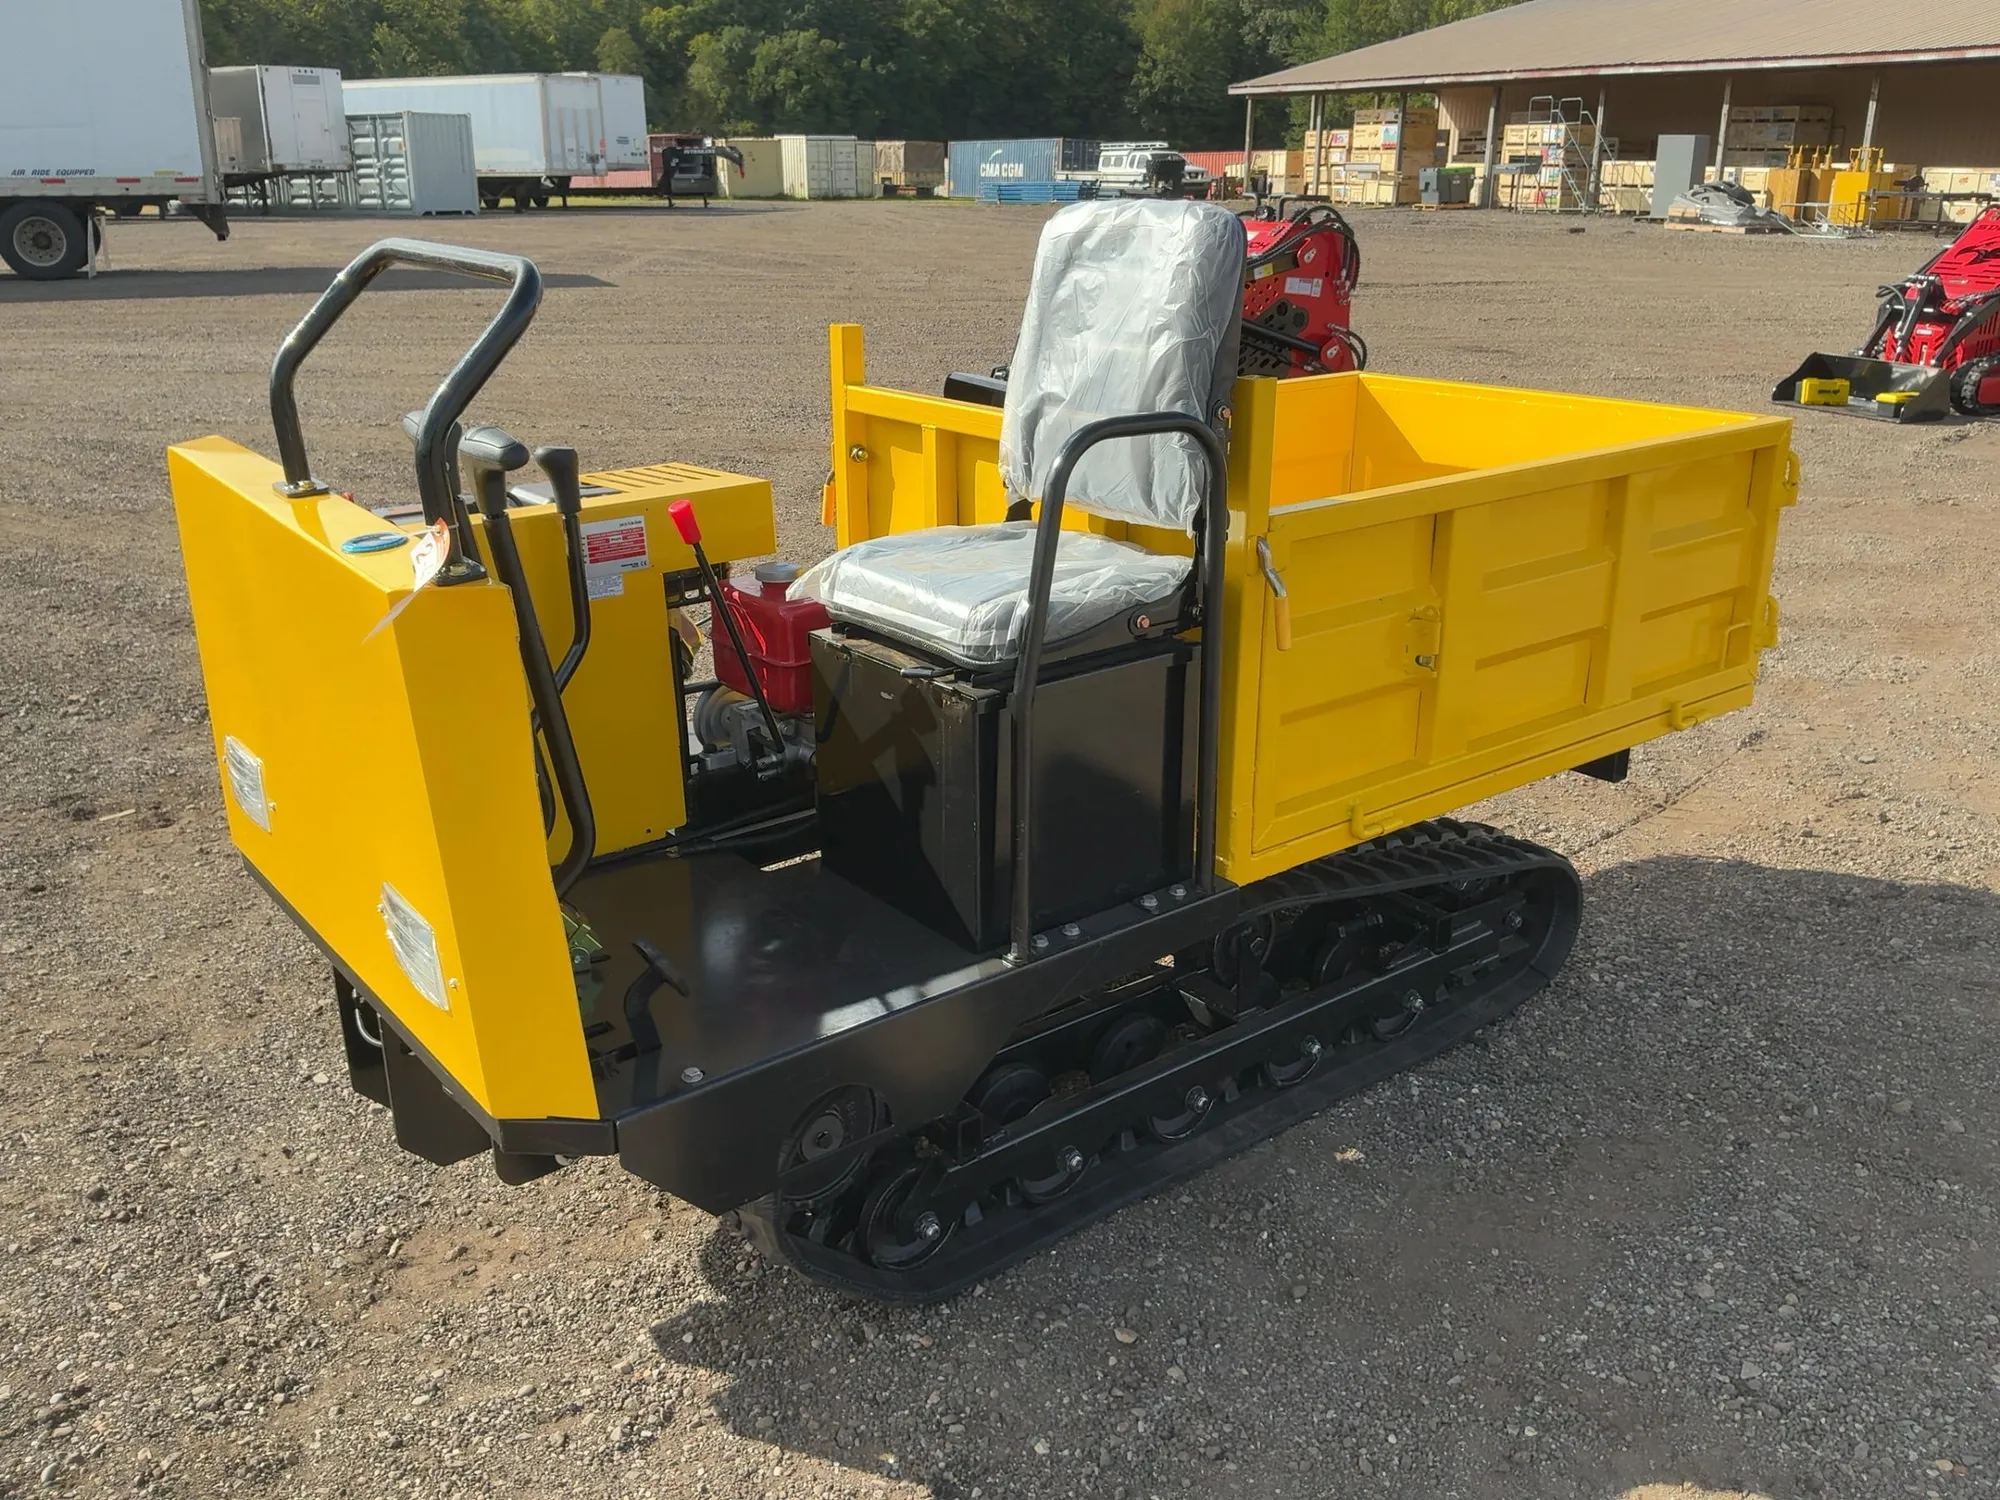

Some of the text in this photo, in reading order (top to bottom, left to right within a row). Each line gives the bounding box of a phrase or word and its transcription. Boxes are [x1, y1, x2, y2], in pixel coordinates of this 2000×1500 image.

[11, 168, 95, 176] AIR RIDE EQUIPPED
[980, 163, 1024, 177] CMA CGM
